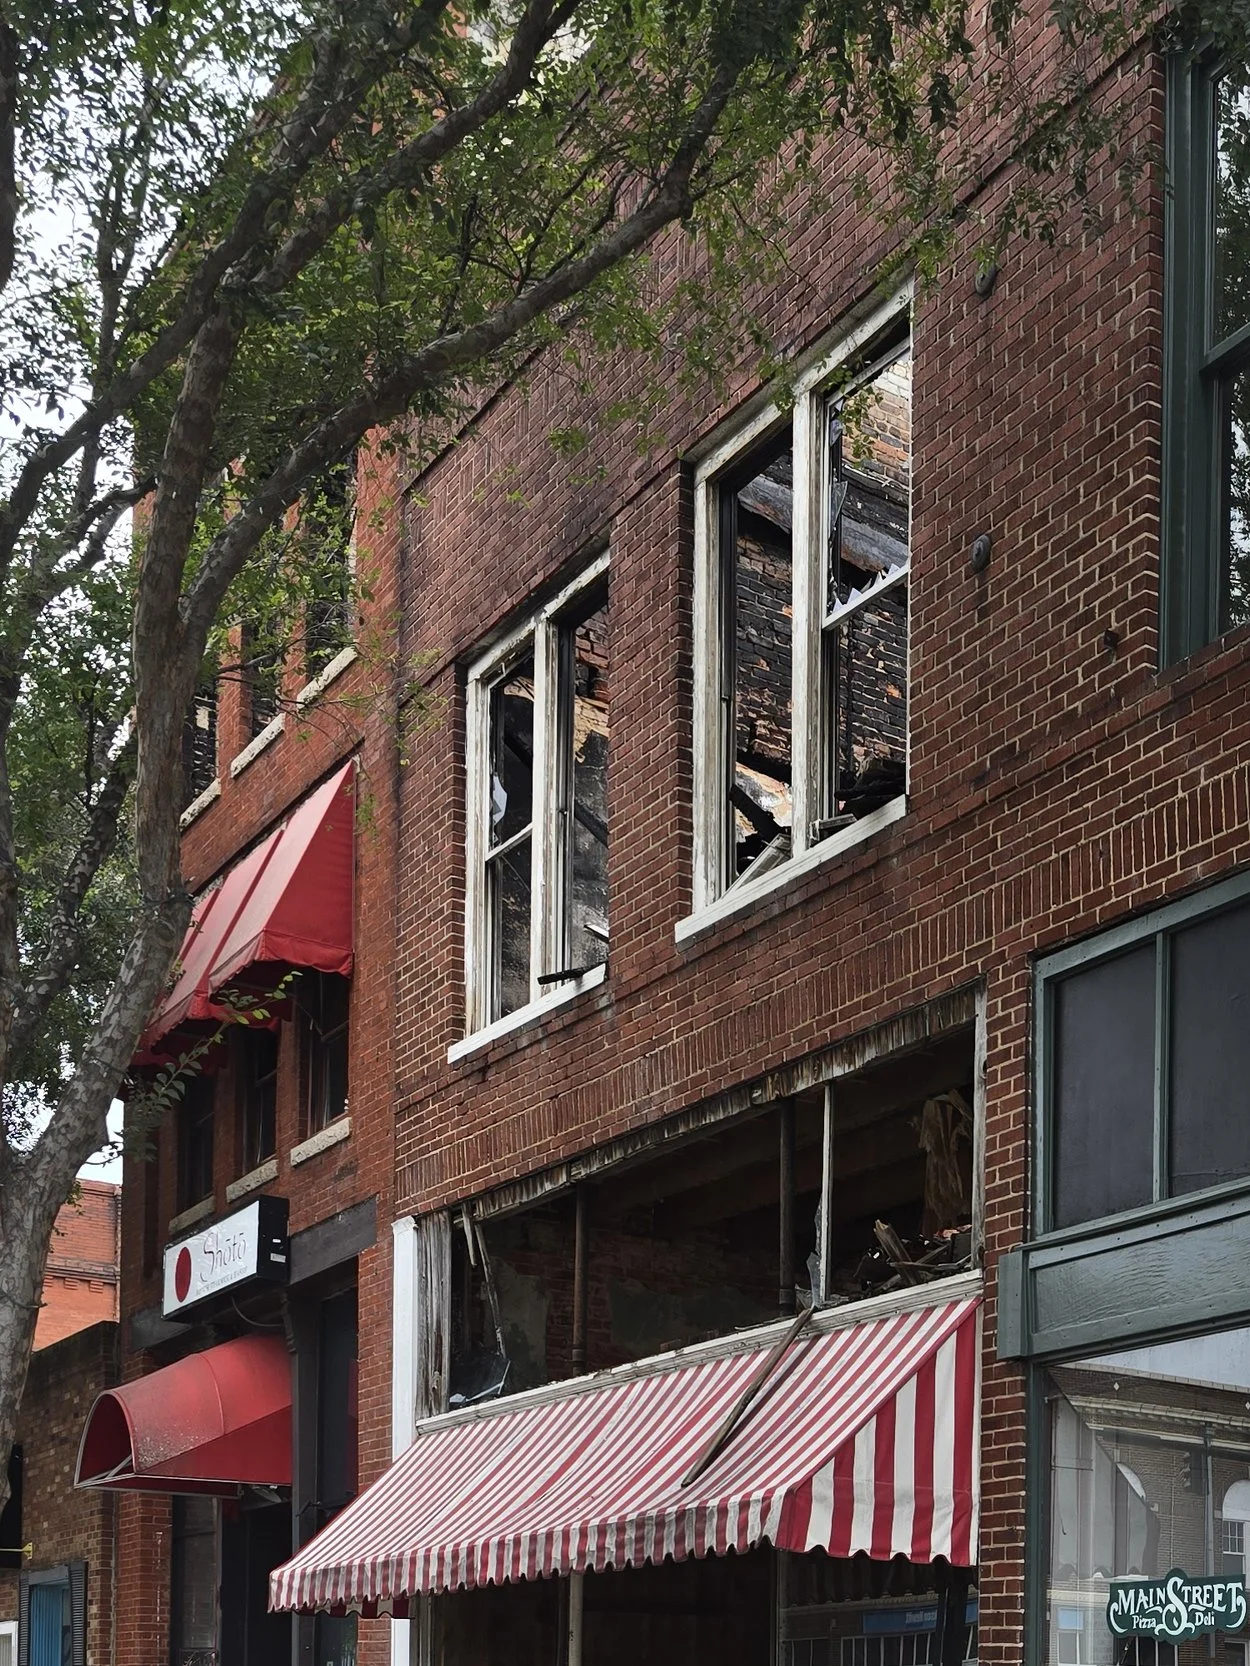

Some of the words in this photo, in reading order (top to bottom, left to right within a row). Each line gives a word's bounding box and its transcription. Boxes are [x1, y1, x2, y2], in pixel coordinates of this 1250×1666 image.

[1113, 1588, 1167, 1620] MAIN
[1162, 1576, 1246, 1636] STREET
[1132, 1615, 1156, 1629] Pizza
[1195, 1611, 1215, 1626] Deli
